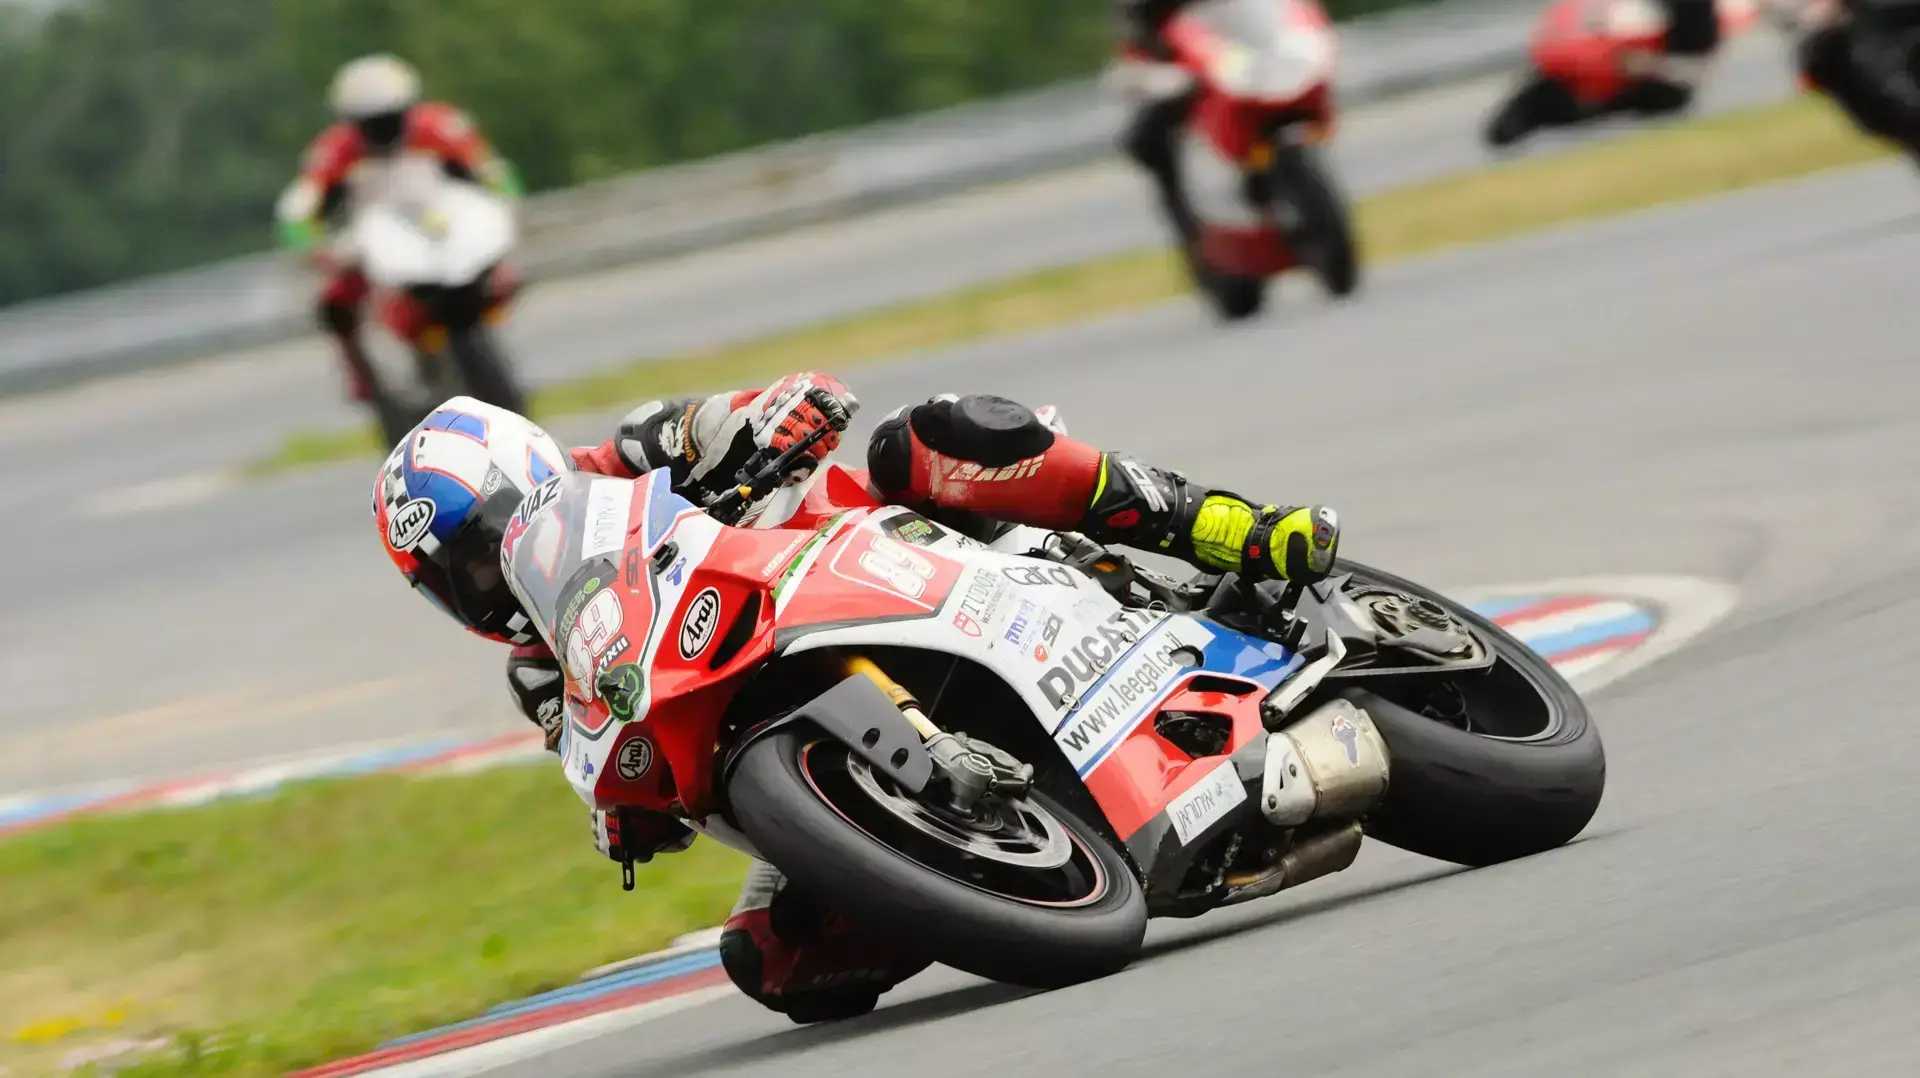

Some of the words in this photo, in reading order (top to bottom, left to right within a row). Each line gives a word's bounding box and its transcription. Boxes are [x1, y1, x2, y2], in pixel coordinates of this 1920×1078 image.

[390, 504, 427, 542] Arai
[960, 568, 998, 616] TUDOR
[684, 596, 713, 656] Arai
[1036, 607, 1151, 711] DUCATI
[1062, 631, 1183, 752] www.leegal.coil
[620, 743, 643, 779] Arai
